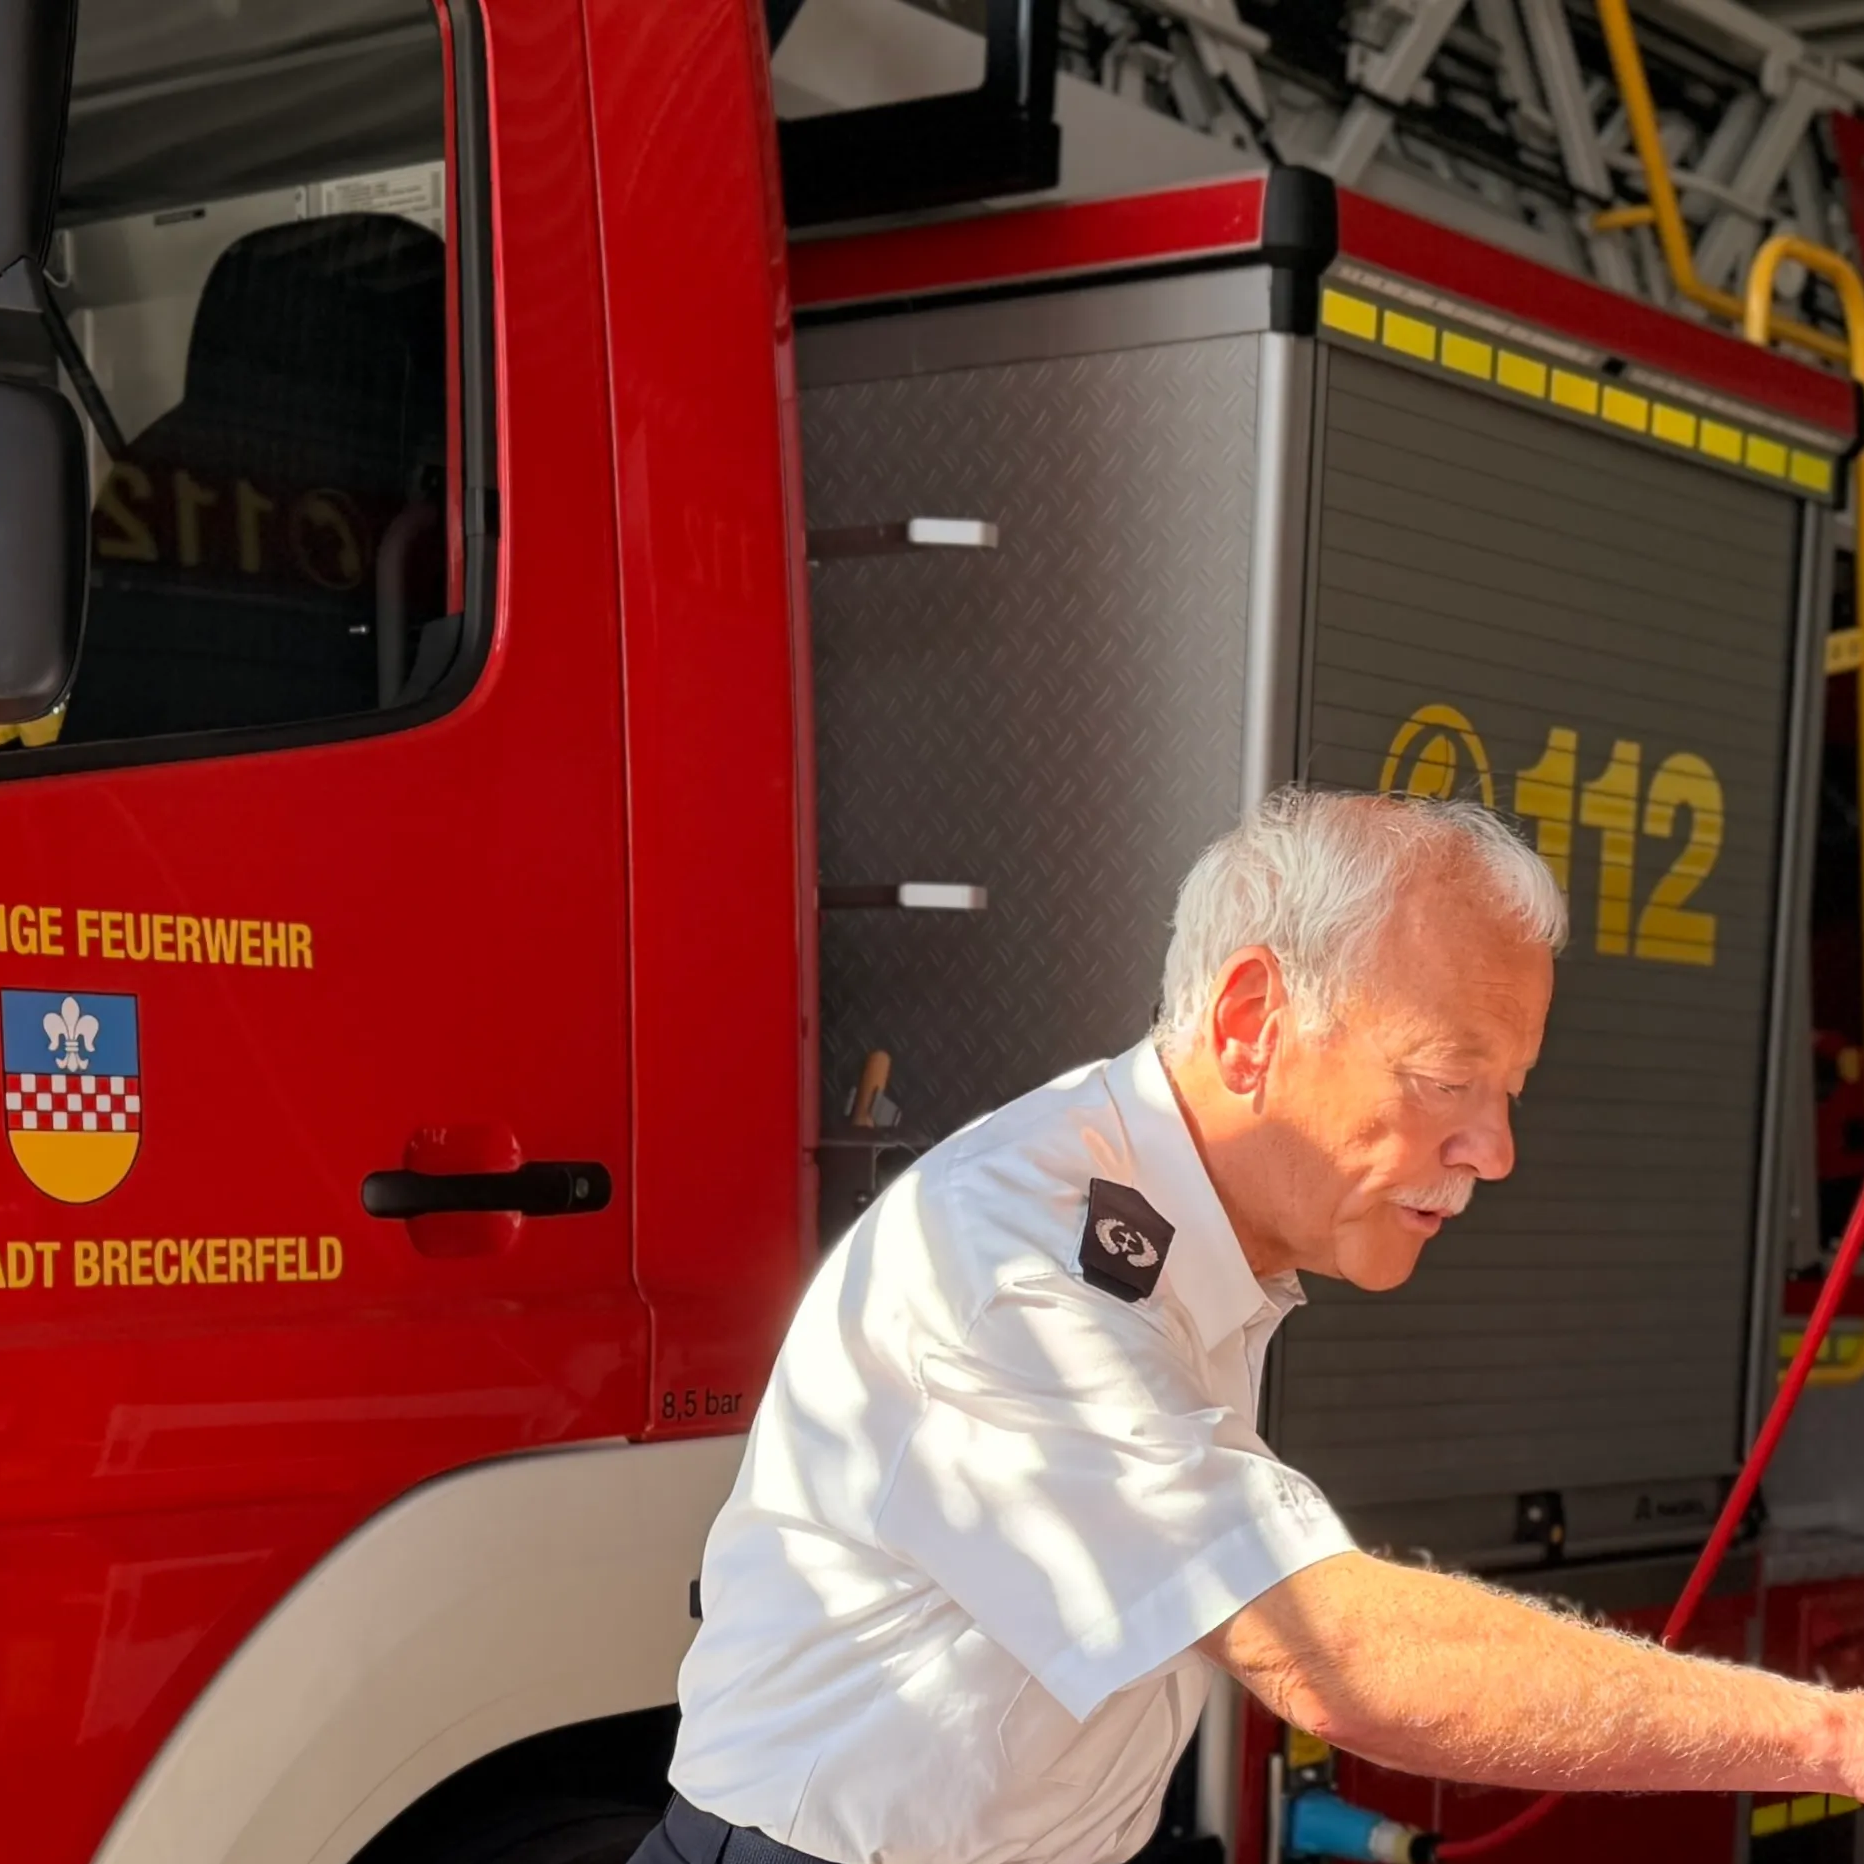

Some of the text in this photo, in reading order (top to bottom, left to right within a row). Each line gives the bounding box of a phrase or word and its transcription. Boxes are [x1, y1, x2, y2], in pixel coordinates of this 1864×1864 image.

[1515, 727, 1724, 965] 112
[75, 908, 313, 969] FEUERWEHR
[73, 1236, 343, 1289] BRECKERFELD
[662, 1387, 743, 1422] 8,5 bar
